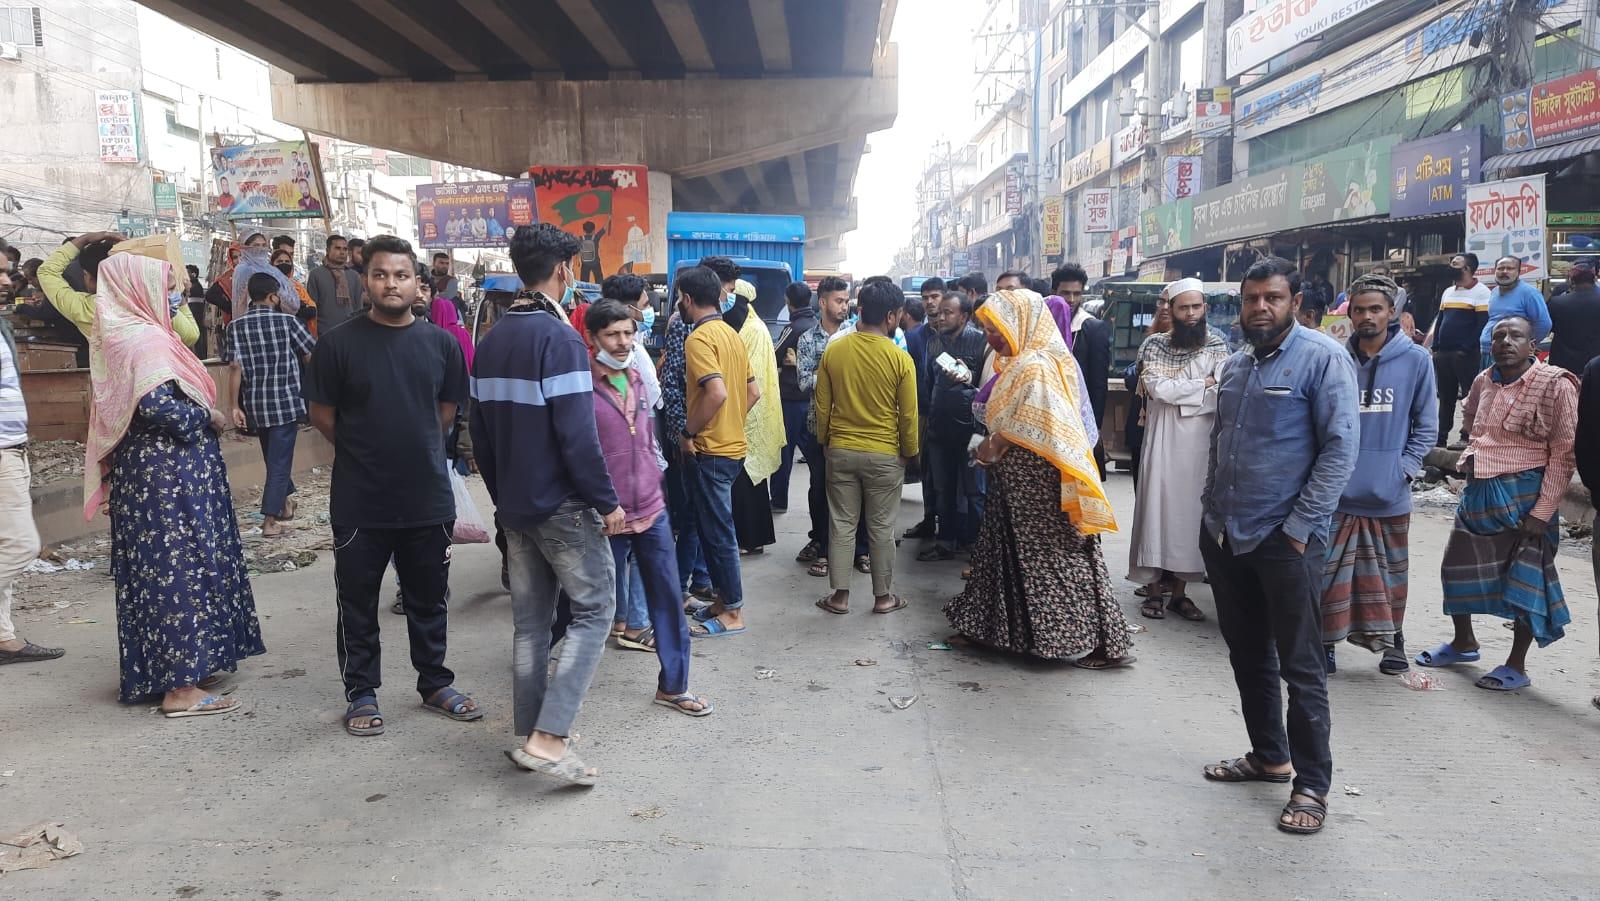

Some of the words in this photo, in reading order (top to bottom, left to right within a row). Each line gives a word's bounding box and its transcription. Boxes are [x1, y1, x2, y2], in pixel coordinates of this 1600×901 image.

[1294, 17, 1328, 41] YOUKI
[1431, 183, 1453, 201] ATM
[1468, 182, 1540, 232] ফটোকপি
[1360, 388, 1394, 404] ESS
